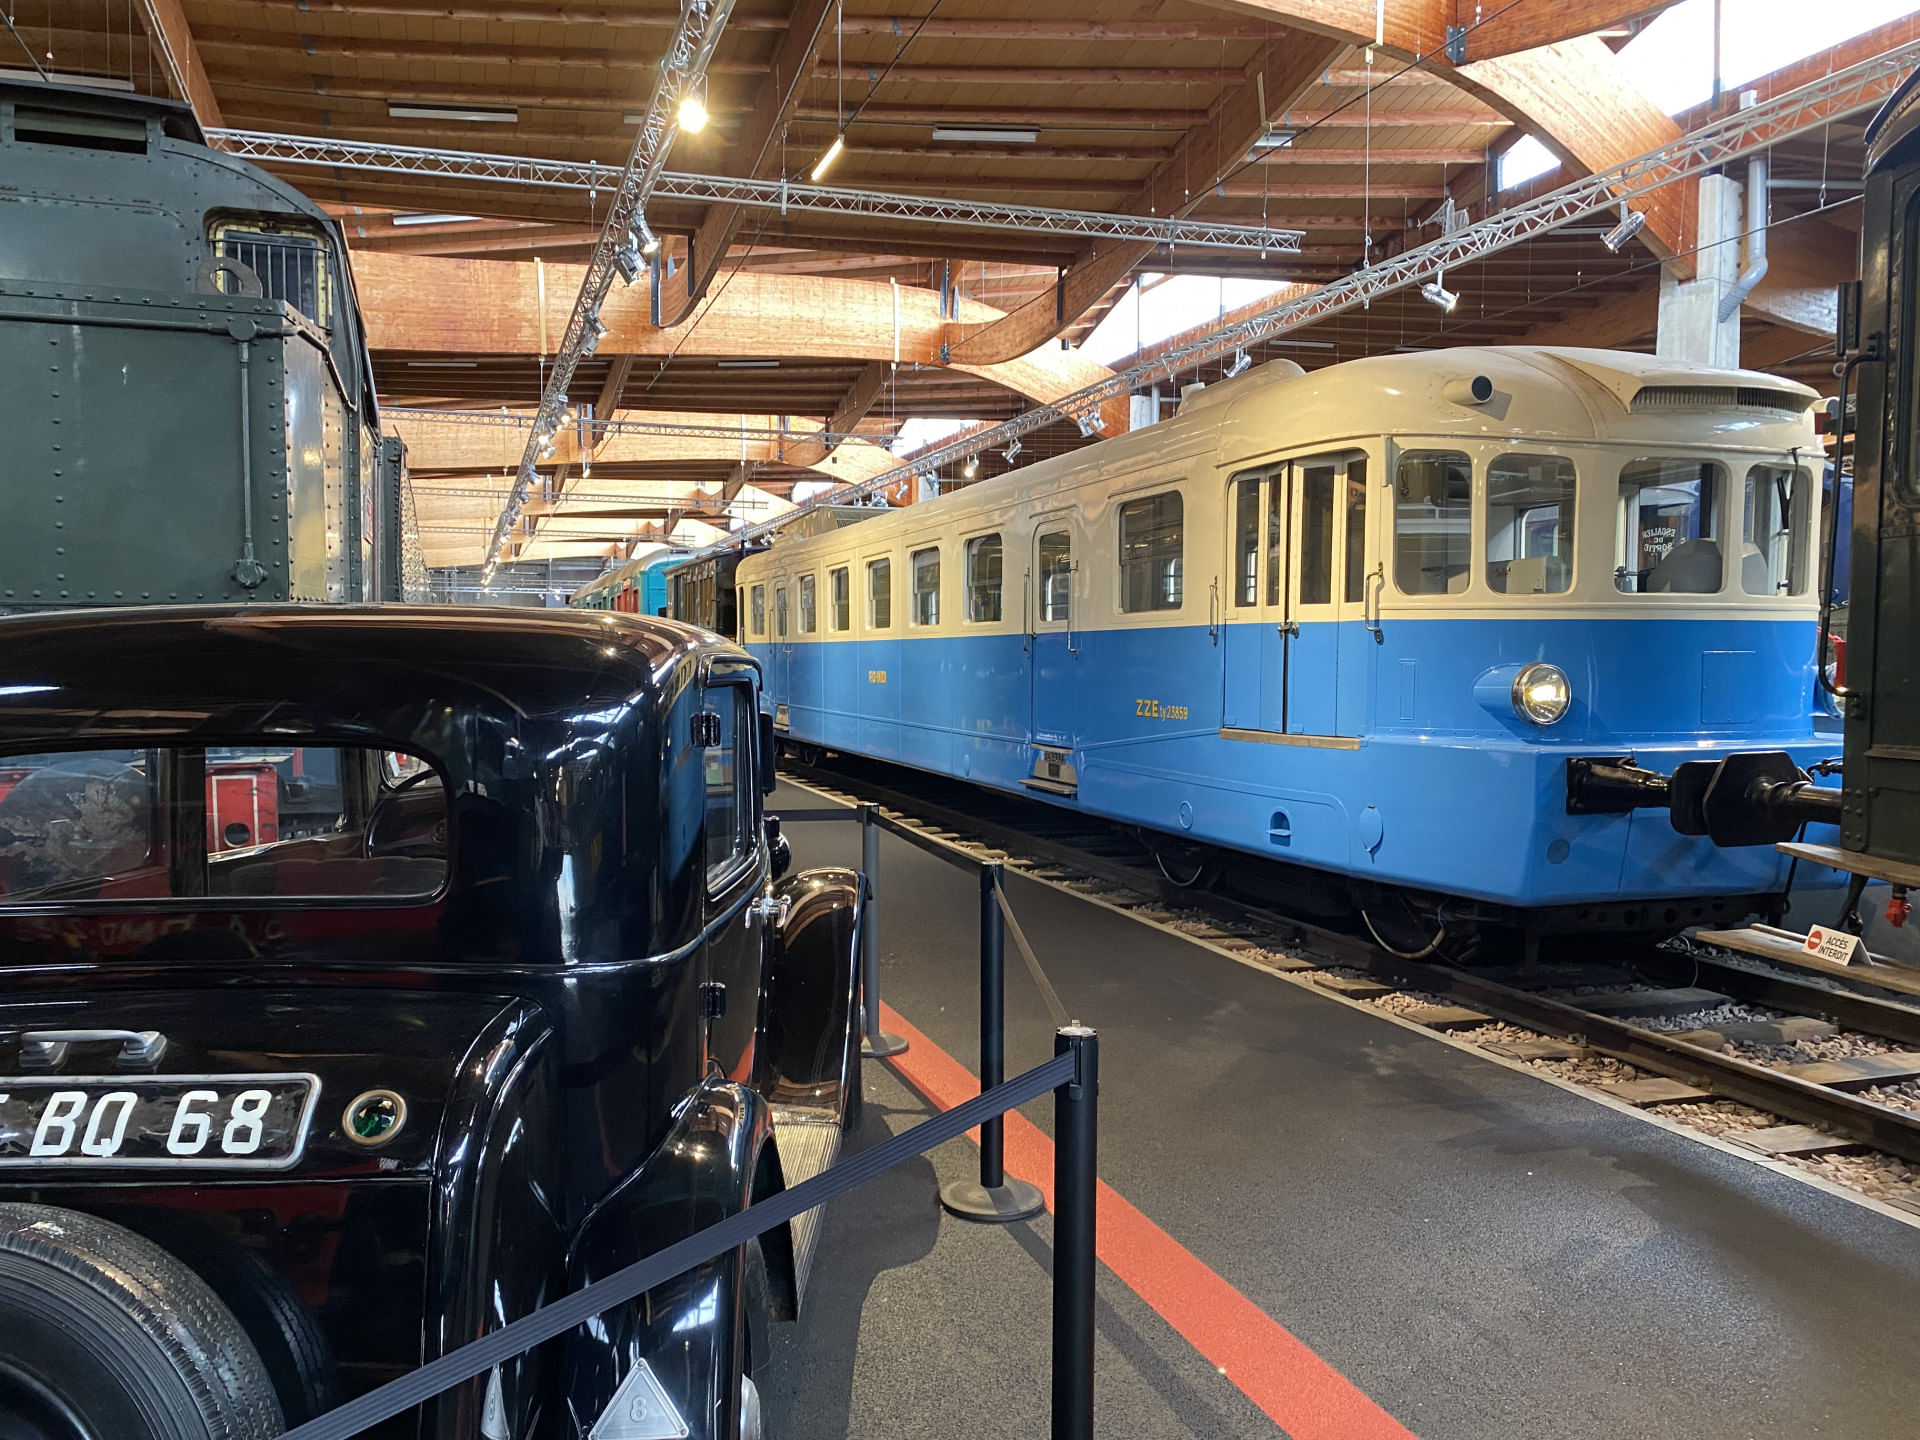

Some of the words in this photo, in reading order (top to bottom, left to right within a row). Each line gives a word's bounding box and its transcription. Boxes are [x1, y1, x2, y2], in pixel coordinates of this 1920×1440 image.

[1826, 936, 1849, 950] ACCÈS
[1817, 945, 1849, 961] INTERDIT
[30, 1090, 138, 1157] BQ
[166, 1089, 272, 1155] 68
